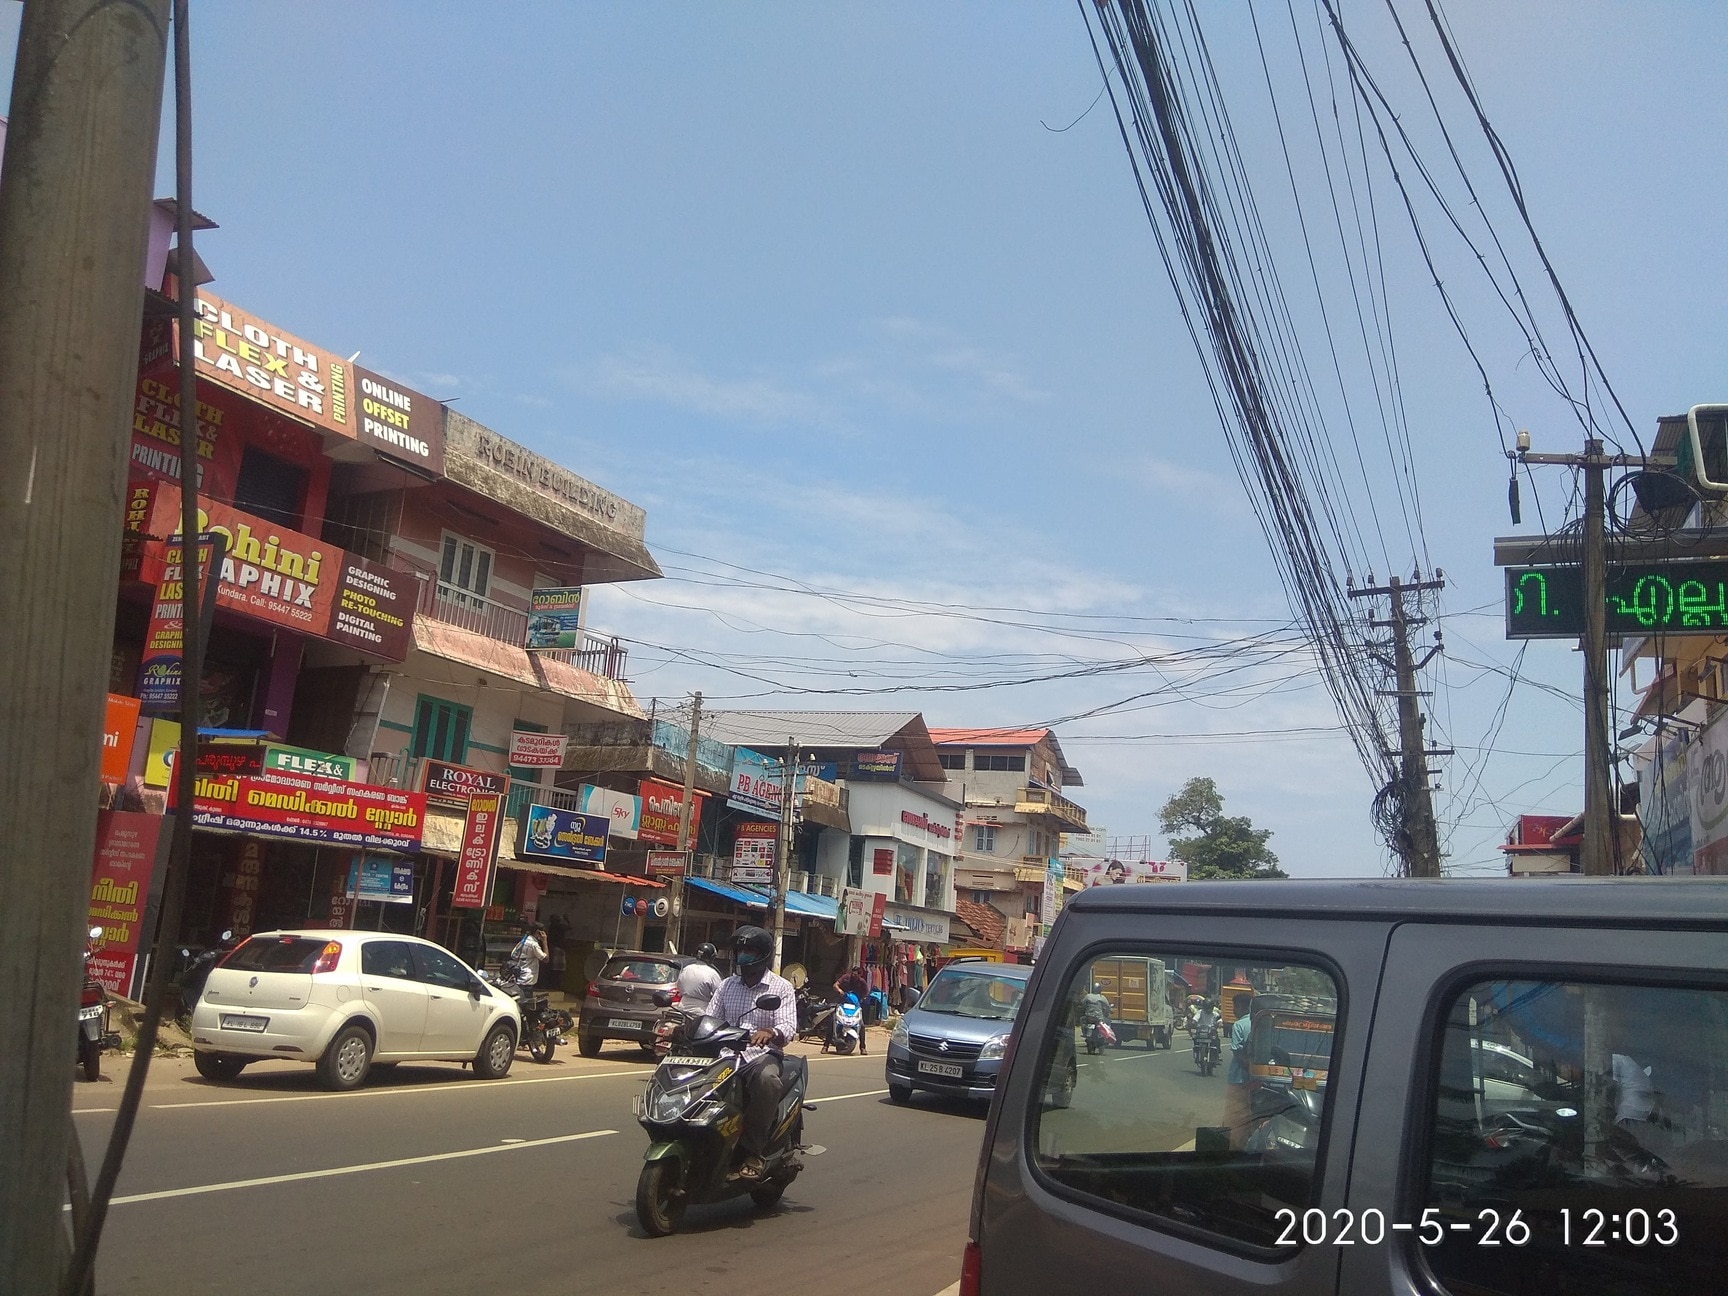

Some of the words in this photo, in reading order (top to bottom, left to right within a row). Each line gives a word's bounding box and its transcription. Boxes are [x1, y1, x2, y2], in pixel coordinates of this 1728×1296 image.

[194, 299, 319, 372] CLOTH
[194, 319, 289, 378] FLEX
[194, 340, 323, 415] LASER
[297, 372, 326, 395] &
[332, 363, 347, 424] PRINTING
[361, 378, 411, 413] ONLINE
[362, 397, 410, 430] OFFSET
[133, 413, 214, 460] LASR
[364, 417, 430, 457] PRINTING
[477, 434, 533, 480] ROBIN
[538, 465, 617, 519] BUILDING
[166, 548, 208, 564] CLH
[164, 566, 204, 581] FLX
[220, 557, 316, 609] APHIX
[348, 566, 390, 588] GRAPHIC
[159, 582, 183, 600] LAS
[343, 589, 376, 607] PHOTO
[345, 577, 397, 601] DESIGNING
[532, 592, 580, 605] റോബിൻ
[250, 595, 267, 609] Call:
[268, 601, 291, 616] 95447
[291, 607, 313, 622] 55222
[341, 599, 404, 627] RE-TOUCHING
[336, 623, 382, 643] PAINTING
[338, 612, 375, 631] DIGITAL
[155, 631, 183, 640] GRAPHI
[333, 763, 343, 776] &
[513, 754, 537, 764] 94473
[442, 768, 496, 789] ROYAL
[737, 774, 751, 793] PB
[247, 789, 357, 819] മെഡിക്കൽ
[333, 831, 362, 842] മുതൽ
[91, 878, 138, 904] നീതി
[920, 1062, 928, 1071] KL
[930, 1064, 938, 1072] 25
[944, 1066, 961, 1076] 4207
